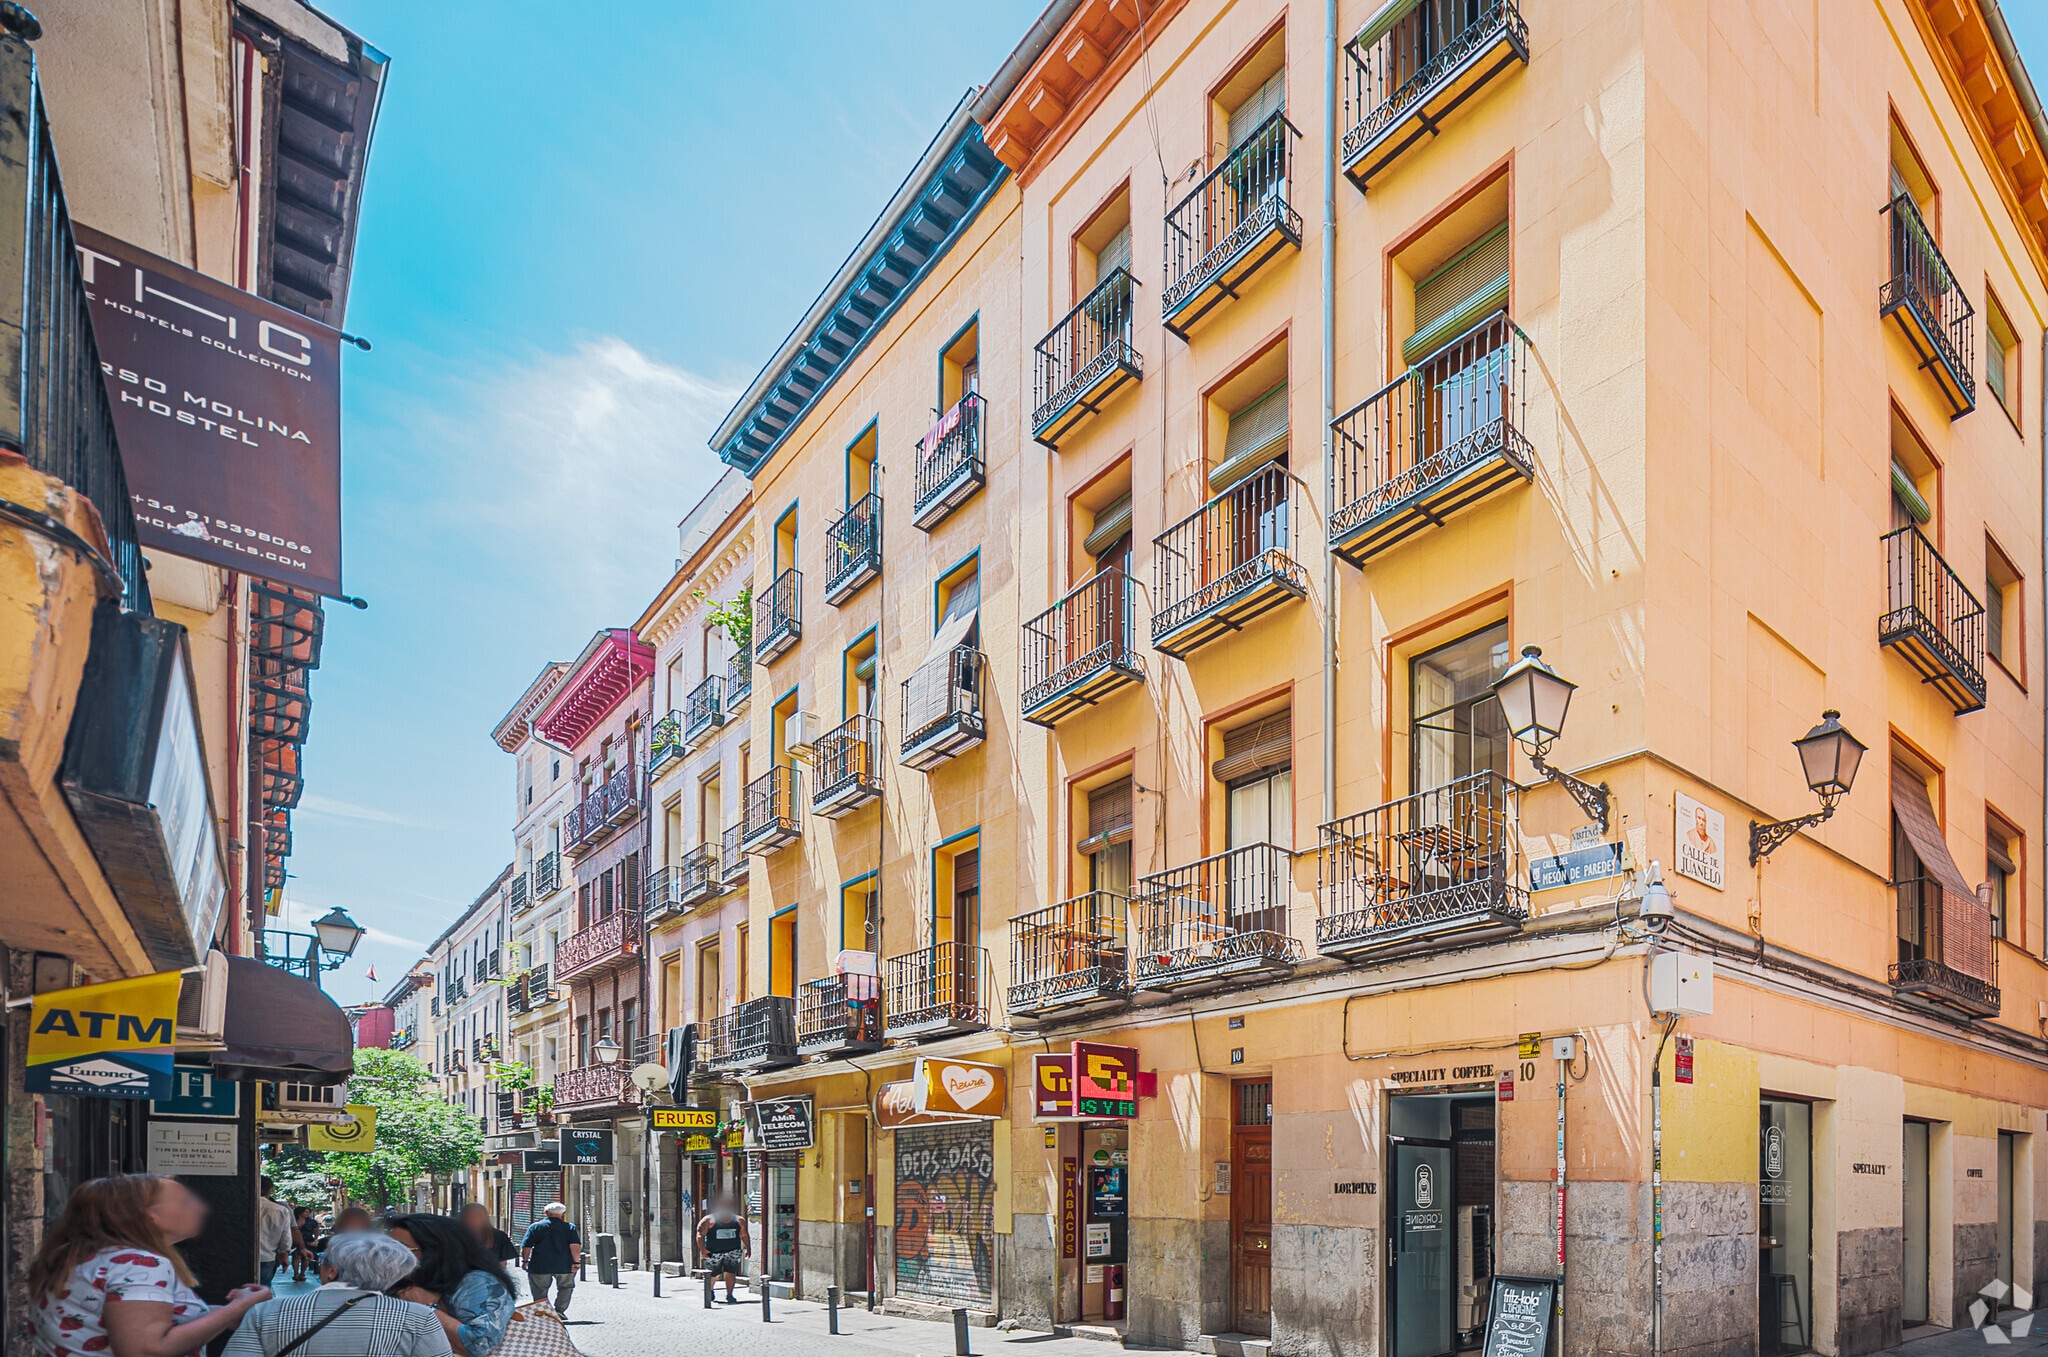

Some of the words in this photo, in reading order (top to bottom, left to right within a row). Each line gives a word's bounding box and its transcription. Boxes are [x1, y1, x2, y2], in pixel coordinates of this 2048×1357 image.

[104, 298, 193, 338] HOSTELS
[201, 335, 311, 382] COLLECTION
[121, 390, 259, 447] HOSTEL
[183, 391, 311, 445] MOLINA
[131, 494, 176, 514] +34
[185, 510, 312, 555] 915398066
[1543, 861, 1557, 870] CALLE
[1560, 857, 1569, 866] DEL
[1682, 843, 1708, 865] CALLE
[1710, 857, 1720, 869] DE
[1543, 868, 1568, 886] MESÓN
[1570, 867, 1581, 880] DE
[1583, 860, 1614, 877] PAREDES
[1681, 857, 1721, 886] JUANELO
[34, 1008, 173, 1045] ATM
[1232, 1050, 1242, 1062] 10
[69, 1066, 134, 1079] Euronet
[1391, 1068, 1446, 1084] SPECIALTY
[1453, 1064, 1494, 1079] COFFEE
[1520, 1062, 1535, 1081] 10
[949, 1078, 986, 1092] Azura
[1102, 1101, 1114, 1115] Y
[656, 1113, 714, 1125] FRUTAS
[762, 1121, 805, 1130] TELECOM
[156, 1130, 231, 1142] THC
[572, 1131, 601, 1139] CRYSTAL
[1853, 1163, 1886, 1175] SPECIALTY
[1966, 1168, 1983, 1178] COFFEE
[1065, 1178, 1075, 1254] TABACOS
[1503, 1288, 1540, 1306] fritz-kola
